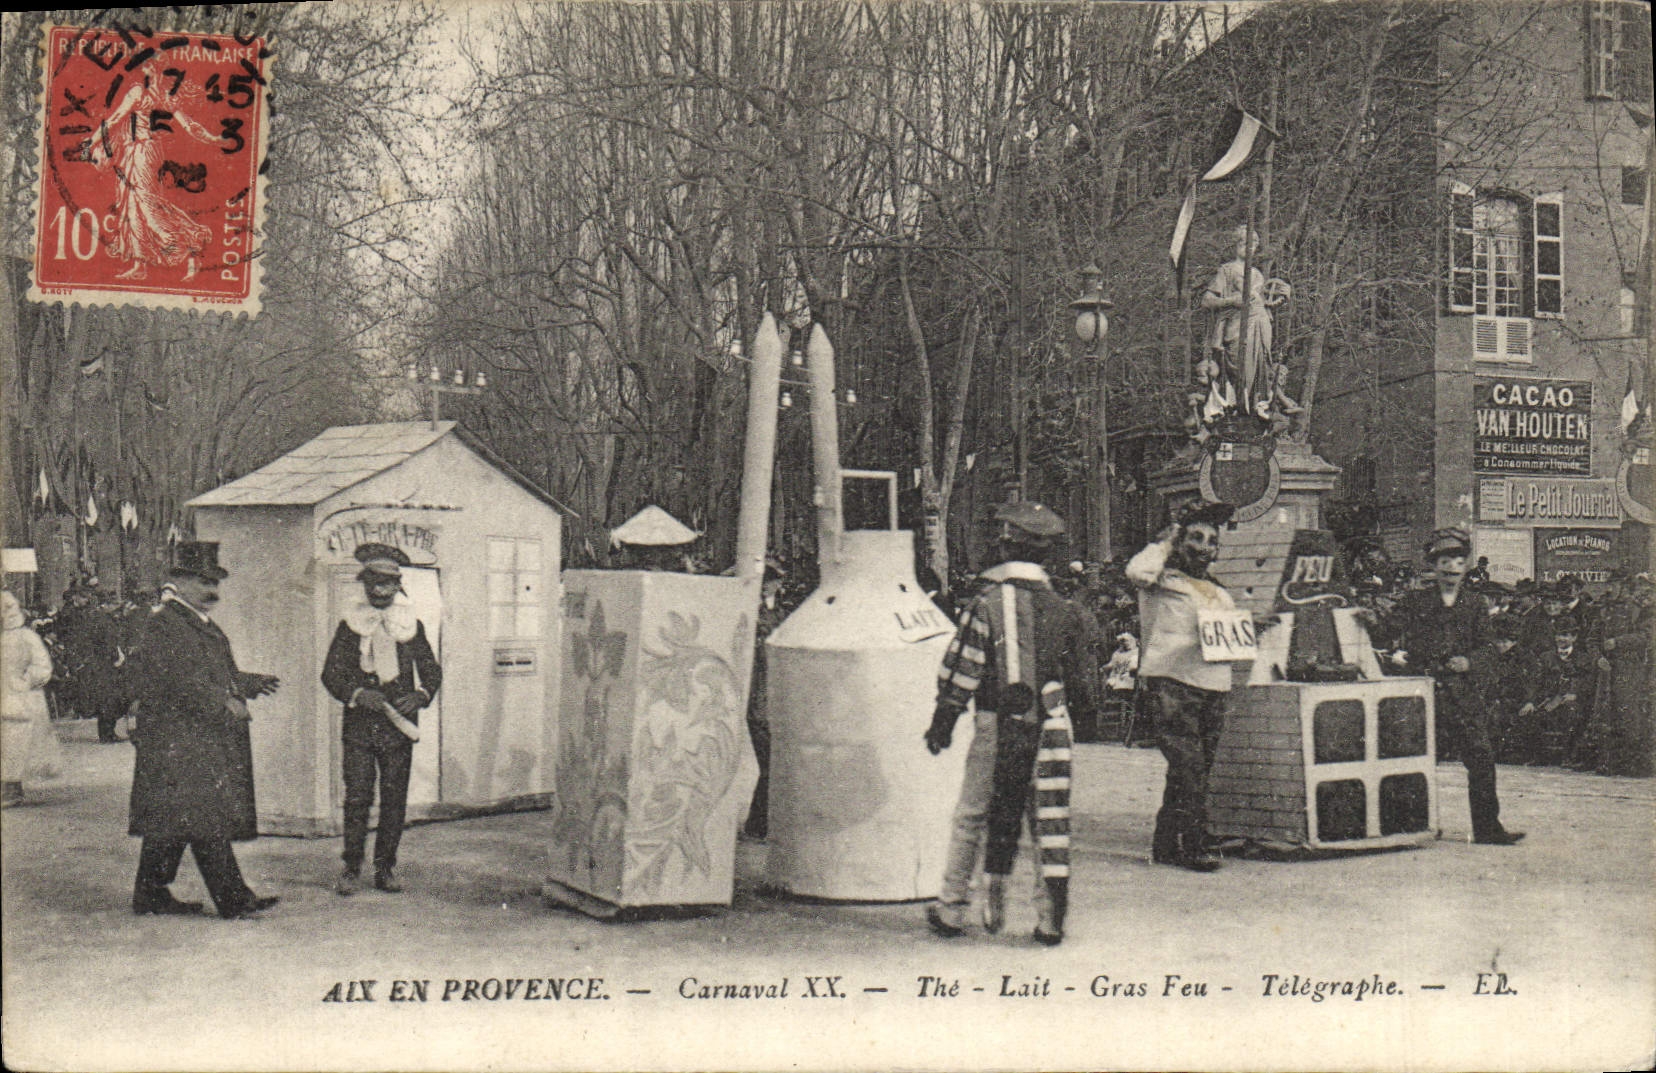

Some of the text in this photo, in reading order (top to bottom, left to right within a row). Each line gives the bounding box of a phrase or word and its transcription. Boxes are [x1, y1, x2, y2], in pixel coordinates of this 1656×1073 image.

[1493, 383, 1574, 407] CACAO
[1477, 409, 1588, 440] VAN HOUTEN
[1481, 442, 1491, 453] LE
[1507, 483, 1526, 519] Le
[1528, 482, 1562, 519] Petit
[1563, 484, 1619, 521] Journal
[1291, 555, 1335, 583] FEU
[893, 609, 942, 630] LAIT
[1201, 619, 1256, 655] GRAS
